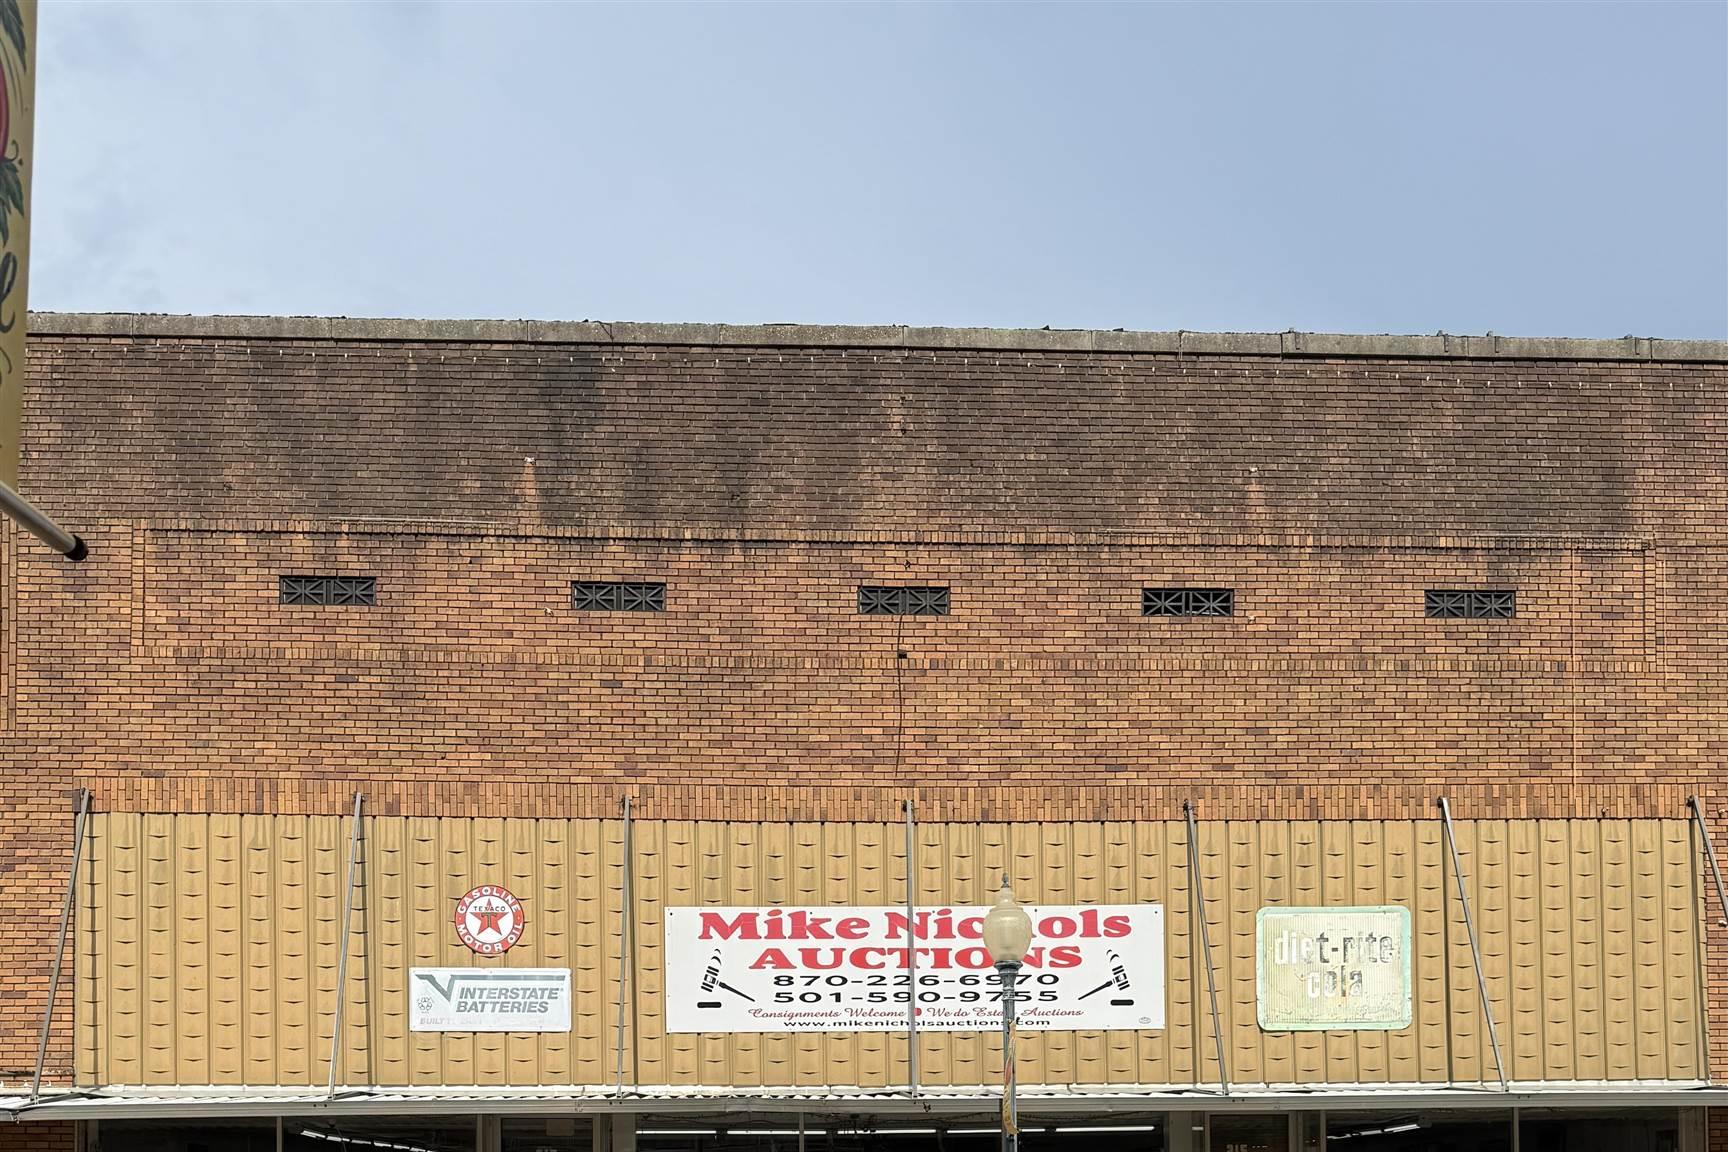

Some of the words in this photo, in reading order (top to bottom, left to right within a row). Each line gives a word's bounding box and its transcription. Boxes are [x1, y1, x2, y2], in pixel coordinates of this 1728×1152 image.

[457, 887, 520, 914] GASOLINE
[698, 909, 871, 940] Mike
[884, 908, 1132, 940] Nicols
[457, 924, 503, 952] MOTOR
[507, 923, 522, 944] OIL
[1274, 929, 1394, 965] diet-rite
[773, 974, 1060, 987] 870-226-6970
[1307, 965, 1363, 998] cola
[459, 987, 560, 1000] INTERSTATE
[773, 991, 1059, 1003] 501-590-9755
[456, 1001, 549, 1013] BATTERIES
[748, 1007, 841, 1021] Consignments
[844, 1007, 907, 1018] Welcome
[926, 1007, 952, 1017] We
[952, 1008, 970, 1017] do
[972, 1006, 1018, 1017] Esta
[1020, 1006, 1084, 1017] Auctions
